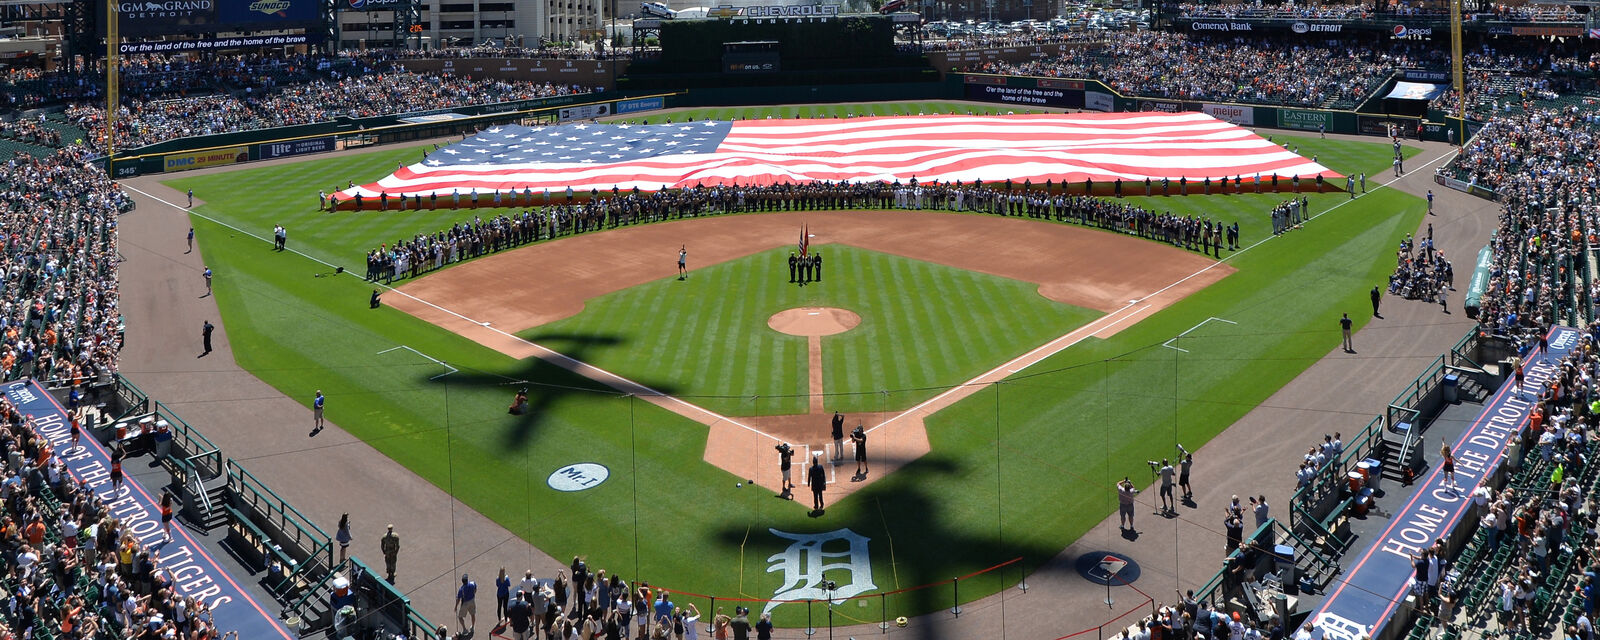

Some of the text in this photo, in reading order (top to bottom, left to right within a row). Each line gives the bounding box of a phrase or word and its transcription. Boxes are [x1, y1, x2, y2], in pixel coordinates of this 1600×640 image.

[110, 0, 210, 12] MGM GRAND
[251, 1, 290, 10] SUNOCO
[747, 5, 841, 17] CHEVROLET
[1231, 22, 1252, 30] Bank
[1310, 24, 1343, 32] DETROIT
[120, 44, 137, 52] O'er
[139, 43, 153, 51] the
[154, 42, 172, 50] land
[173, 41, 182, 49] of
[214, 39, 228, 47] and
[1213, 105, 1242, 118] meijer
[1284, 110, 1326, 121] EASTERN
[271, 143, 291, 157] Lite
[168, 157, 195, 167] DMC
[208, 153, 235, 162] MINUTE
[1469, 394, 1530, 450] DETROIT
[1454, 450, 1489, 478] THE
[33, 413, 73, 447] HOME
[76, 460, 113, 488] THE
[99, 485, 173, 550] DETROIT
[158, 545, 232, 610] TIGERS
[1382, 503, 1448, 560] HOME
